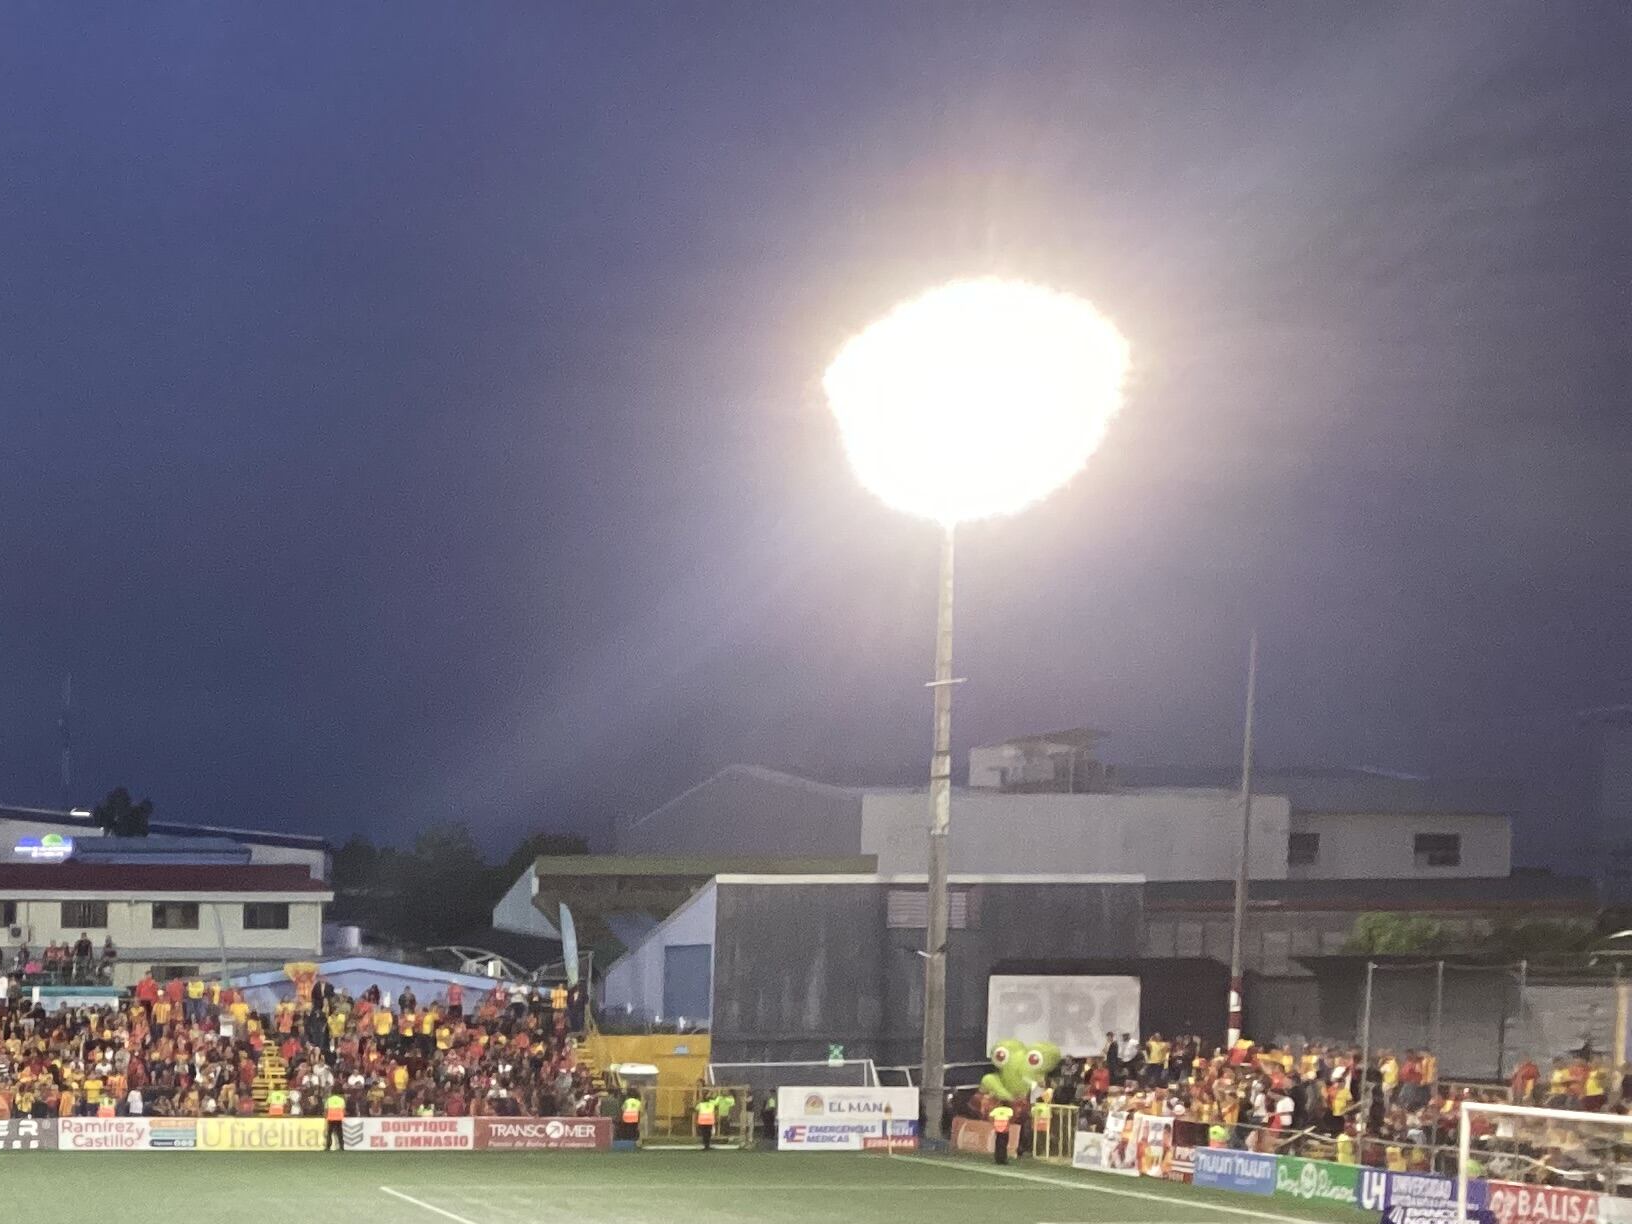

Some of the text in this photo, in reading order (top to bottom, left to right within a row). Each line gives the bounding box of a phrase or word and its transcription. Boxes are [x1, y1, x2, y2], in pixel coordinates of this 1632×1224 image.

[61, 1119, 134, 1134] Ramírez
[381, 1120, 458, 1133] BOUTIQUE
[72, 1134, 135, 1148] Castillo
[371, 1135, 469, 1148] EL GIMNASIO
[1518, 1189, 1599, 1224] BALISA
